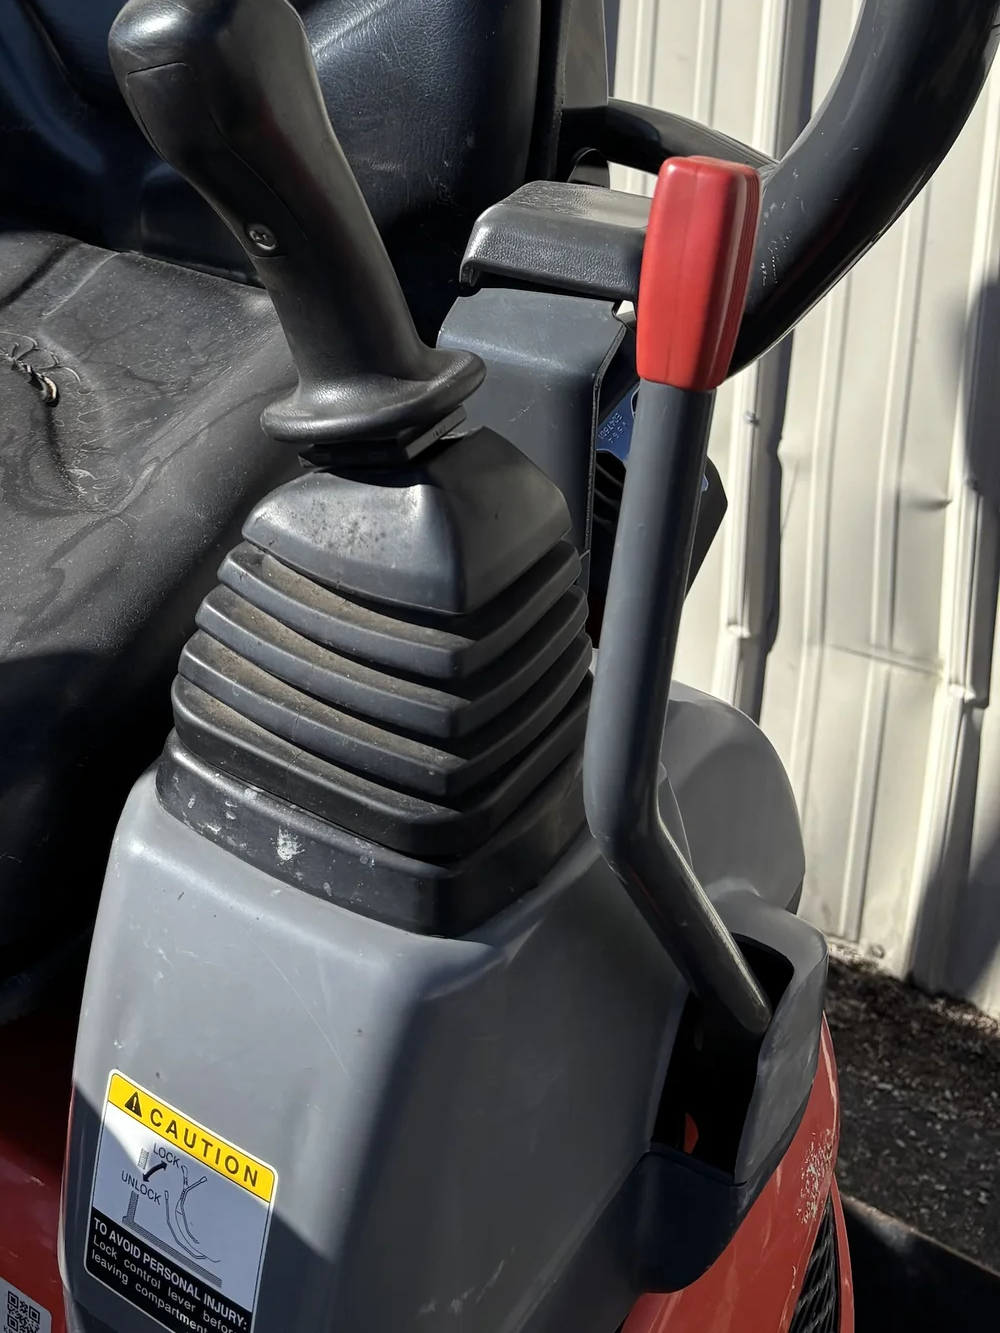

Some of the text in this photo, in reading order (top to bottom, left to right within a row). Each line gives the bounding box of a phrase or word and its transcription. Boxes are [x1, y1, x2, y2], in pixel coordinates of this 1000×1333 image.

[149, 1107, 259, 1188] CAUTION
[152, 1142, 181, 1168] LOCK
[120, 1169, 162, 1206] UNLOCK
[91, 1248, 129, 1285] leaving
[92, 1233, 238, 1333] Lock control lever befor
[93, 1217, 248, 1331] TO AVOID PERSONAL INJURY:
